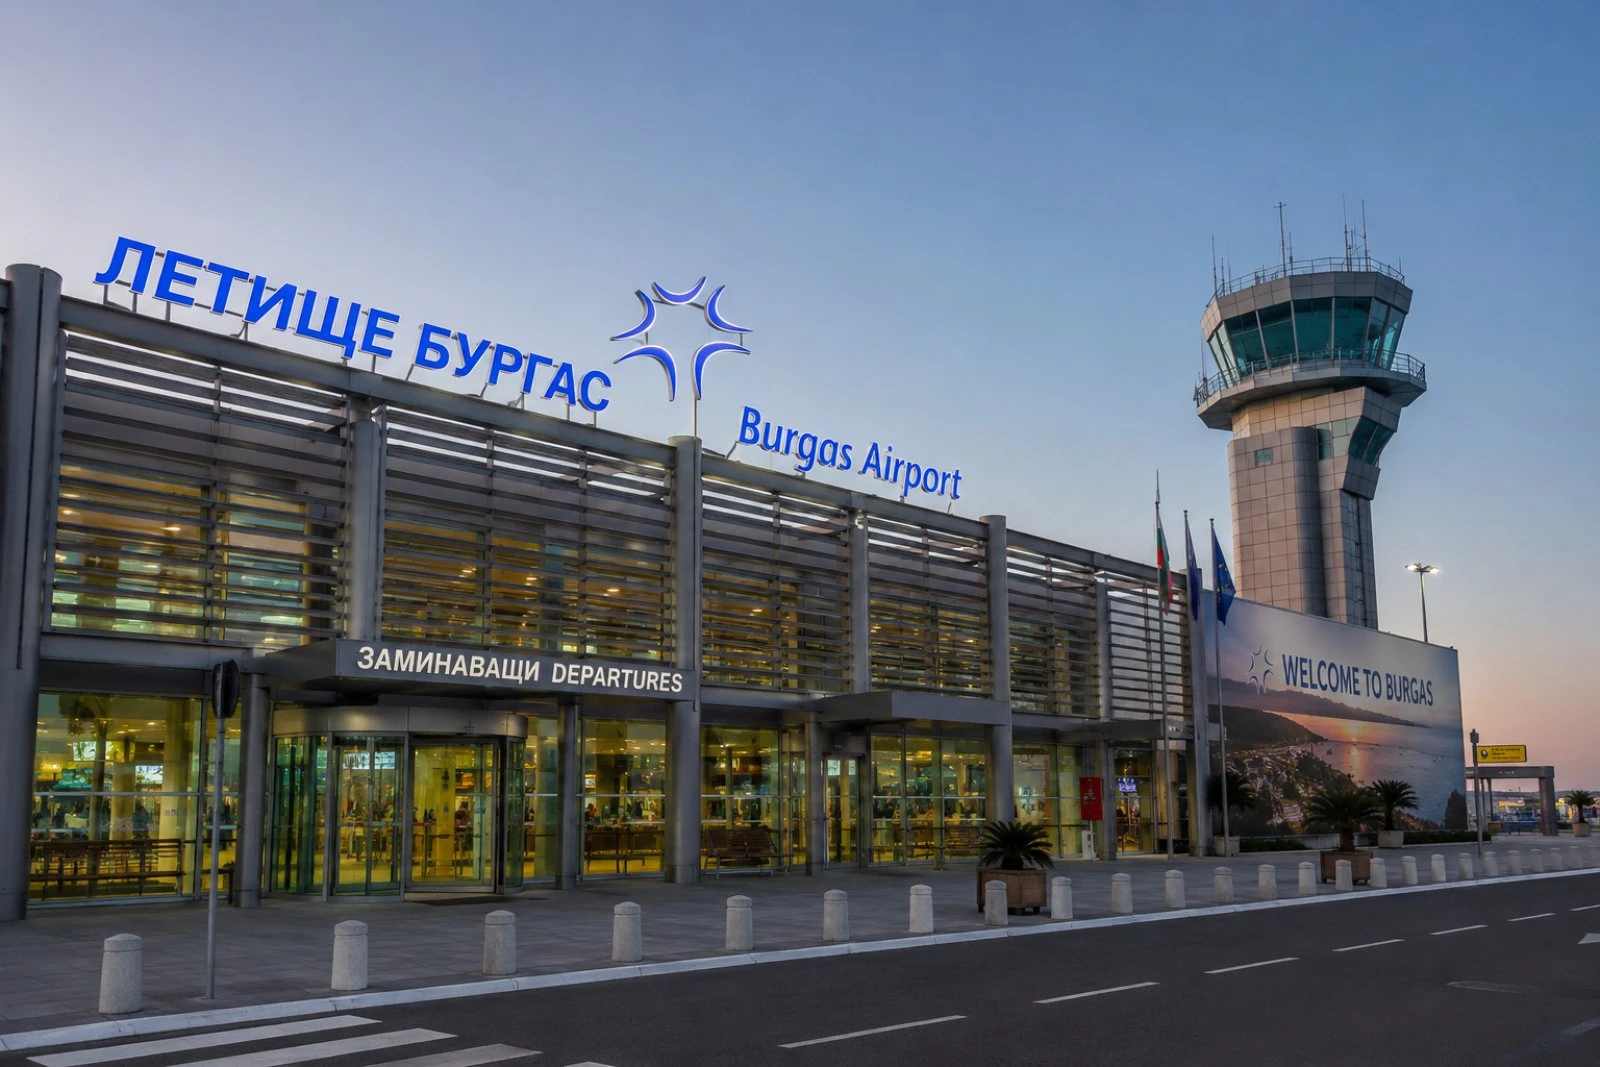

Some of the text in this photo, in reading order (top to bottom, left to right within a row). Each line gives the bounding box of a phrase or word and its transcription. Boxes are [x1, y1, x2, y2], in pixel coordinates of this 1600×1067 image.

[94, 236, 612, 412] ЛЕТИЩЕ БУРГАС
[738, 405, 962, 500] Burgas Airport
[357, 646, 540, 684] ЗАМИНАВАЩИ
[551, 662, 683, 693] DEPARTURES
[1282, 654, 1434, 706] WELCOME TO BURGAS
